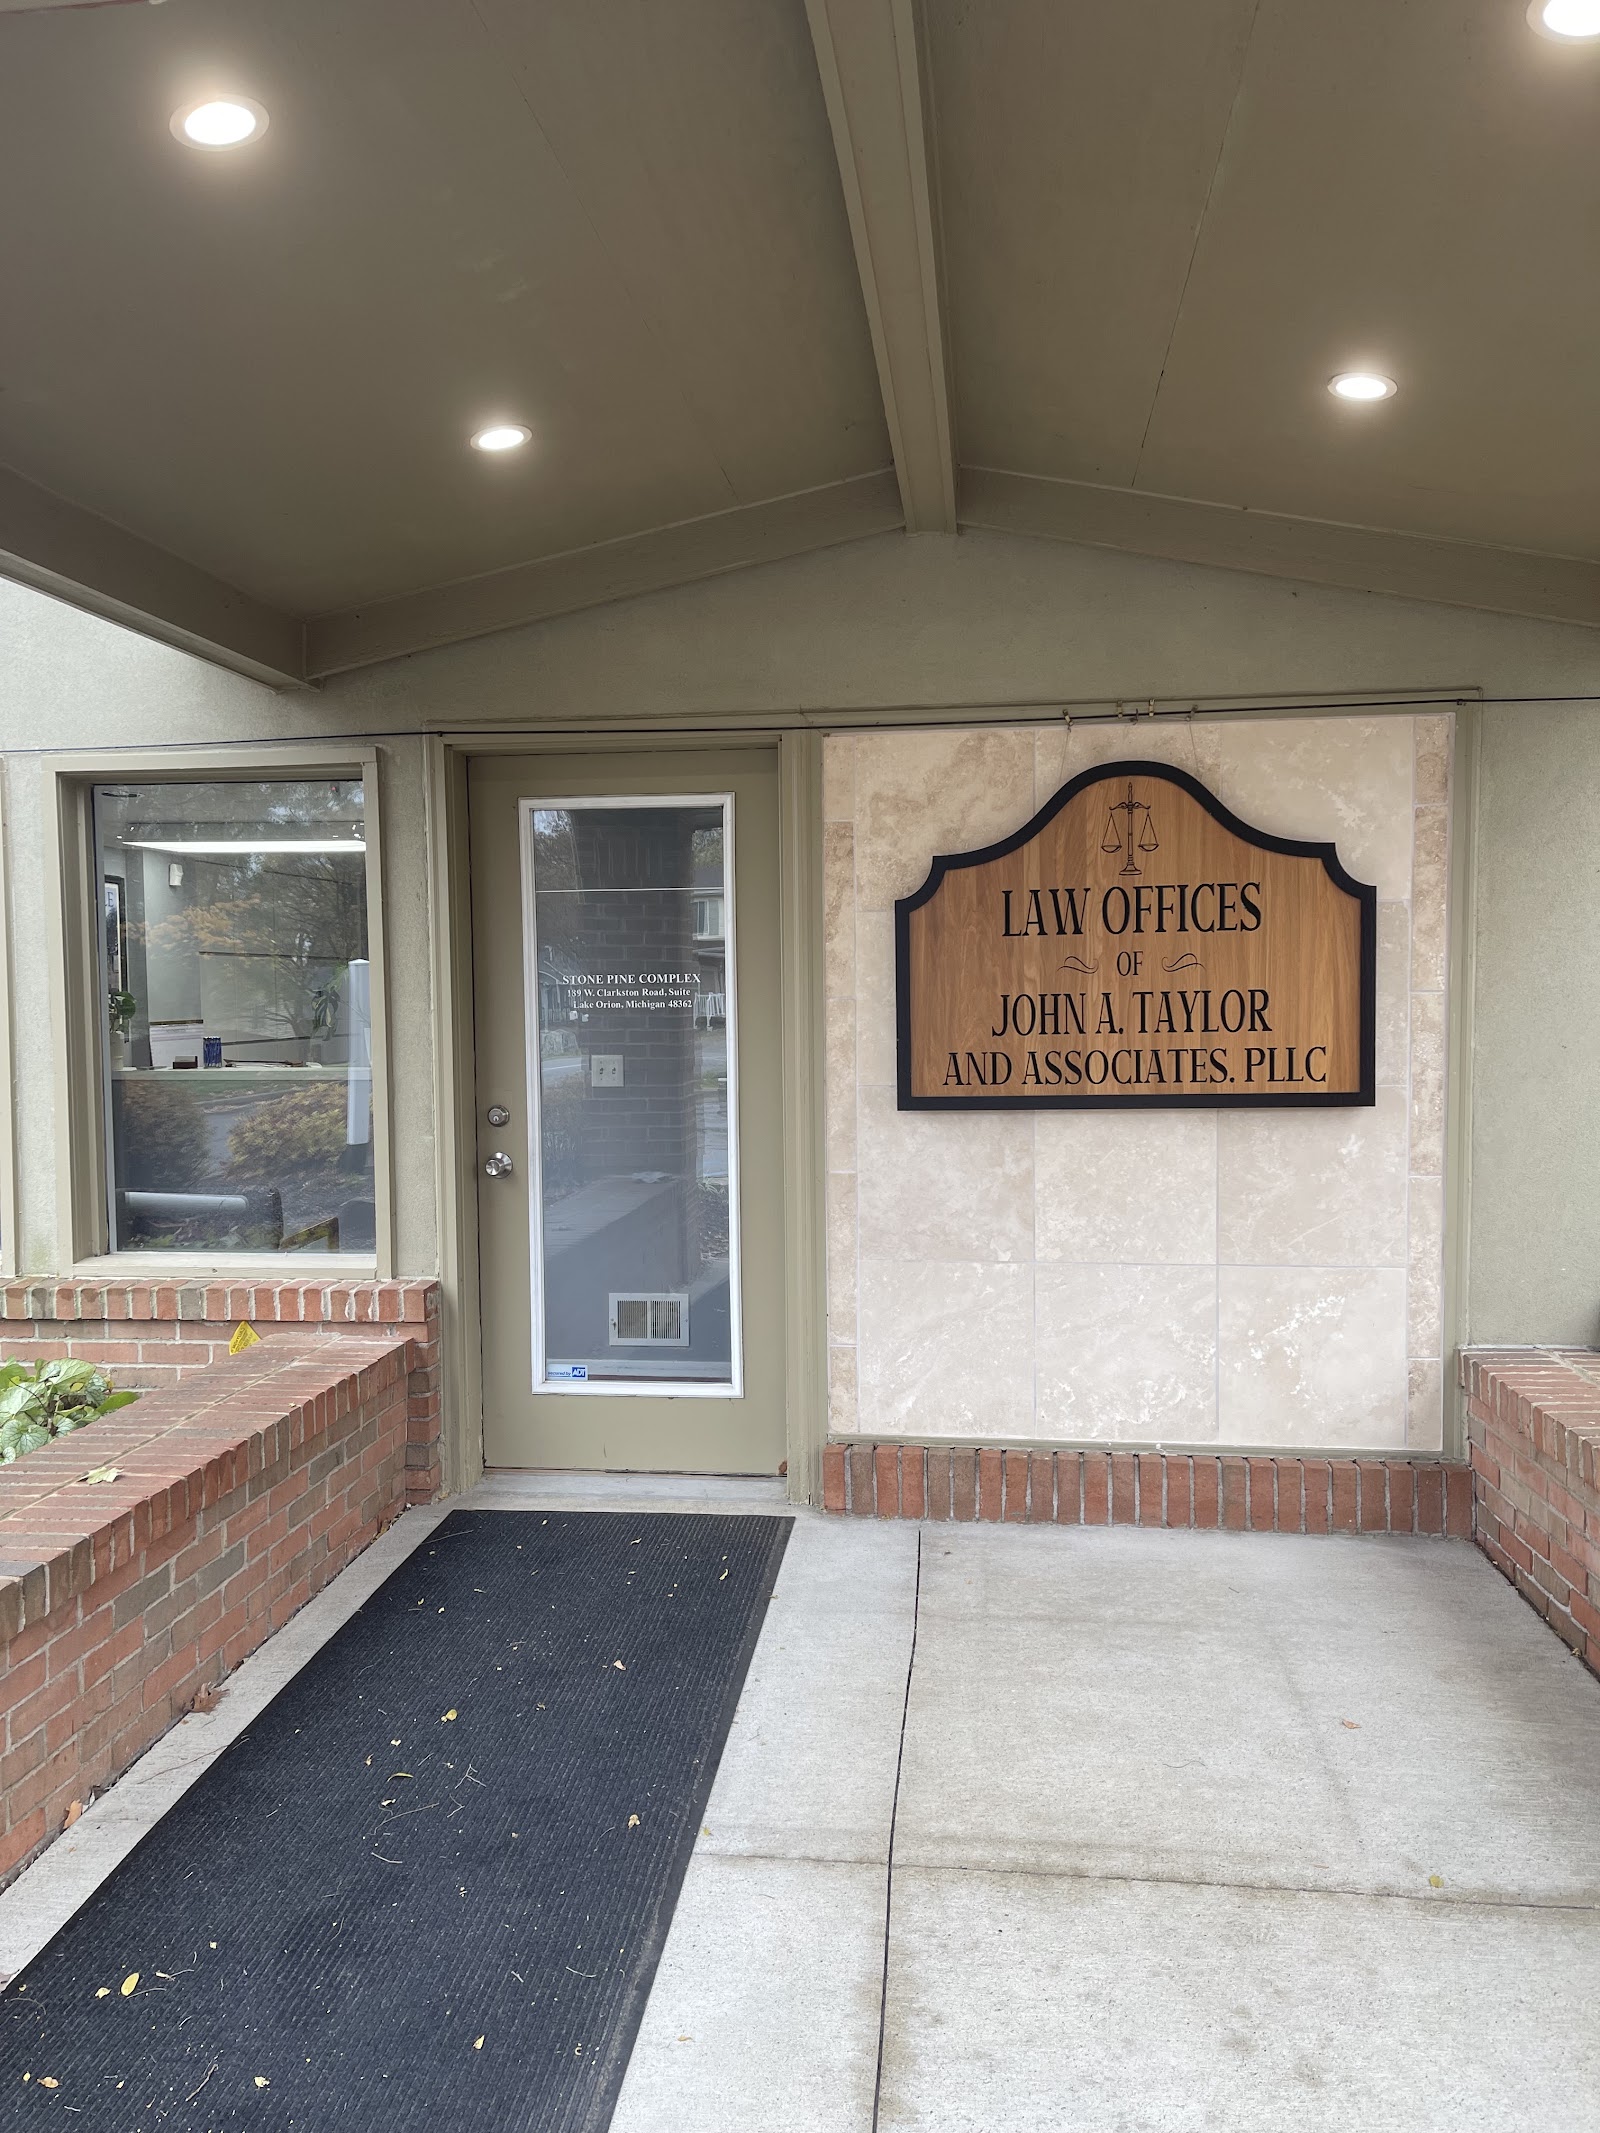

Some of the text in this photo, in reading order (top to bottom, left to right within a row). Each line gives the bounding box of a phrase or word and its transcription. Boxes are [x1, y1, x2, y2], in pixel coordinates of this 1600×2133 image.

[1002, 881, 1262, 937] LAW OFFICES
[1116, 951, 1144, 977] OF
[562, 973, 702, 985] STONE PINE COMPLEX
[584, 989, 595, 997] W.
[597, 988, 639, 997] Clarkston
[642, 988, 668, 997] Road,
[668, 987, 691, 996] Suite
[573, 999, 693, 1010] Lake Orion, Michigan 48362
[992, 988, 1273, 1037] JOHN A. TAYLOR
[942, 1045, 1328, 1086] AND ASSOCIATES. PLLC
[572, 1368, 585, 1377] ADT
